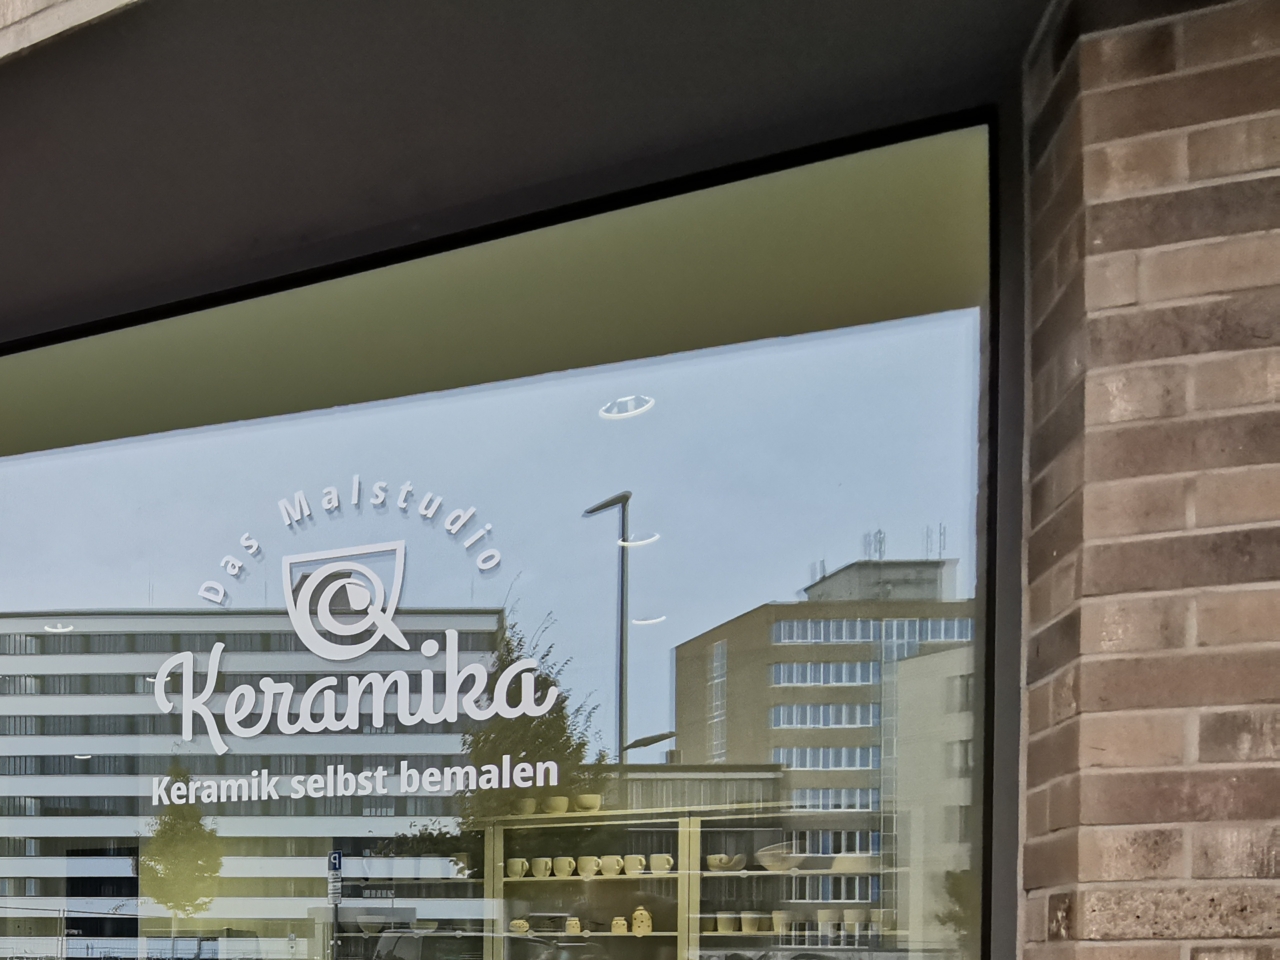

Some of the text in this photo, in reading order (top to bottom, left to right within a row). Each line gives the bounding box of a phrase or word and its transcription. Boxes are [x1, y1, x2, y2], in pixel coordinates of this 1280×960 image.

[198, 474, 502, 605] Das Malstudio
[154, 629, 559, 755] Keramika
[151, 754, 559, 806] Keramik selbst bemalen
